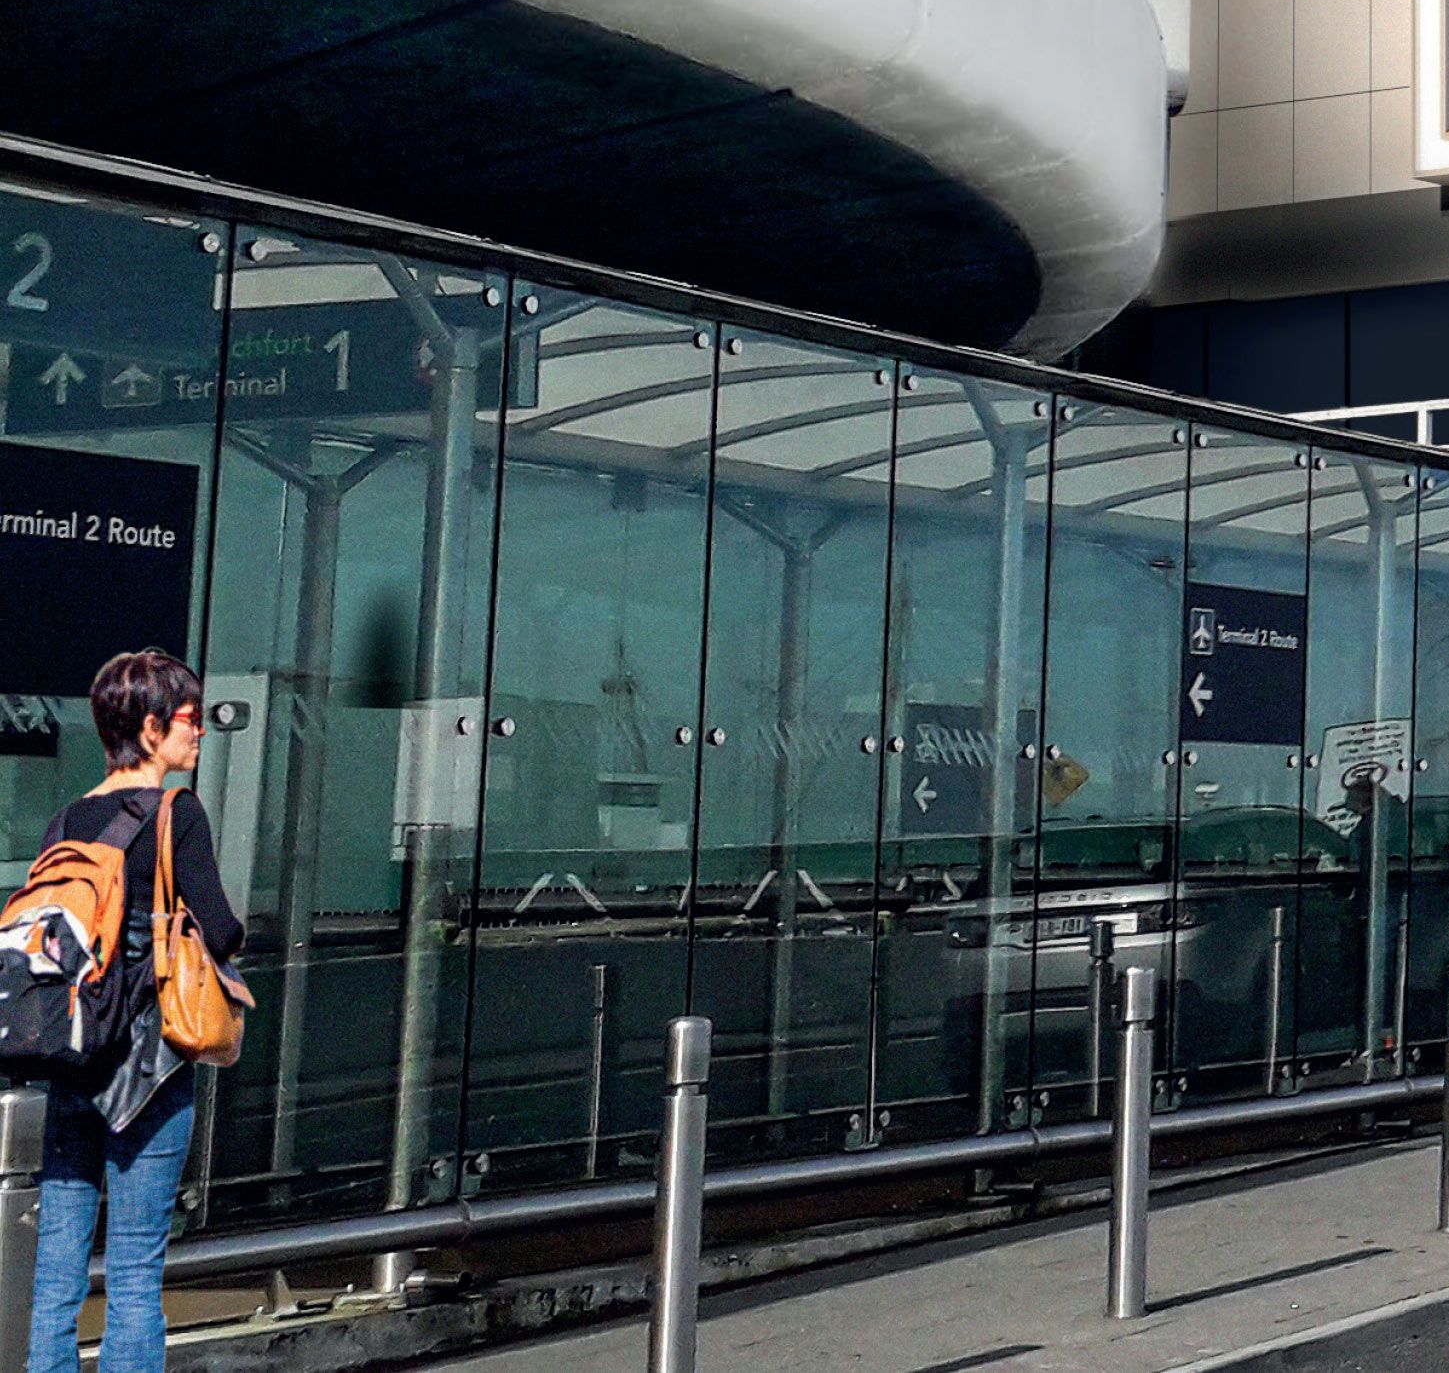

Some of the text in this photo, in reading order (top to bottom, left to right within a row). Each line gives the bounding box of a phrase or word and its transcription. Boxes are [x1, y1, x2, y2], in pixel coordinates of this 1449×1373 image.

[7, 232, 51, 312] 2
[323, 329, 350, 392] 1
[0, 510, 176, 548] rminal 2 Route
[1217, 625, 1298, 649] Terminal 2 Route
